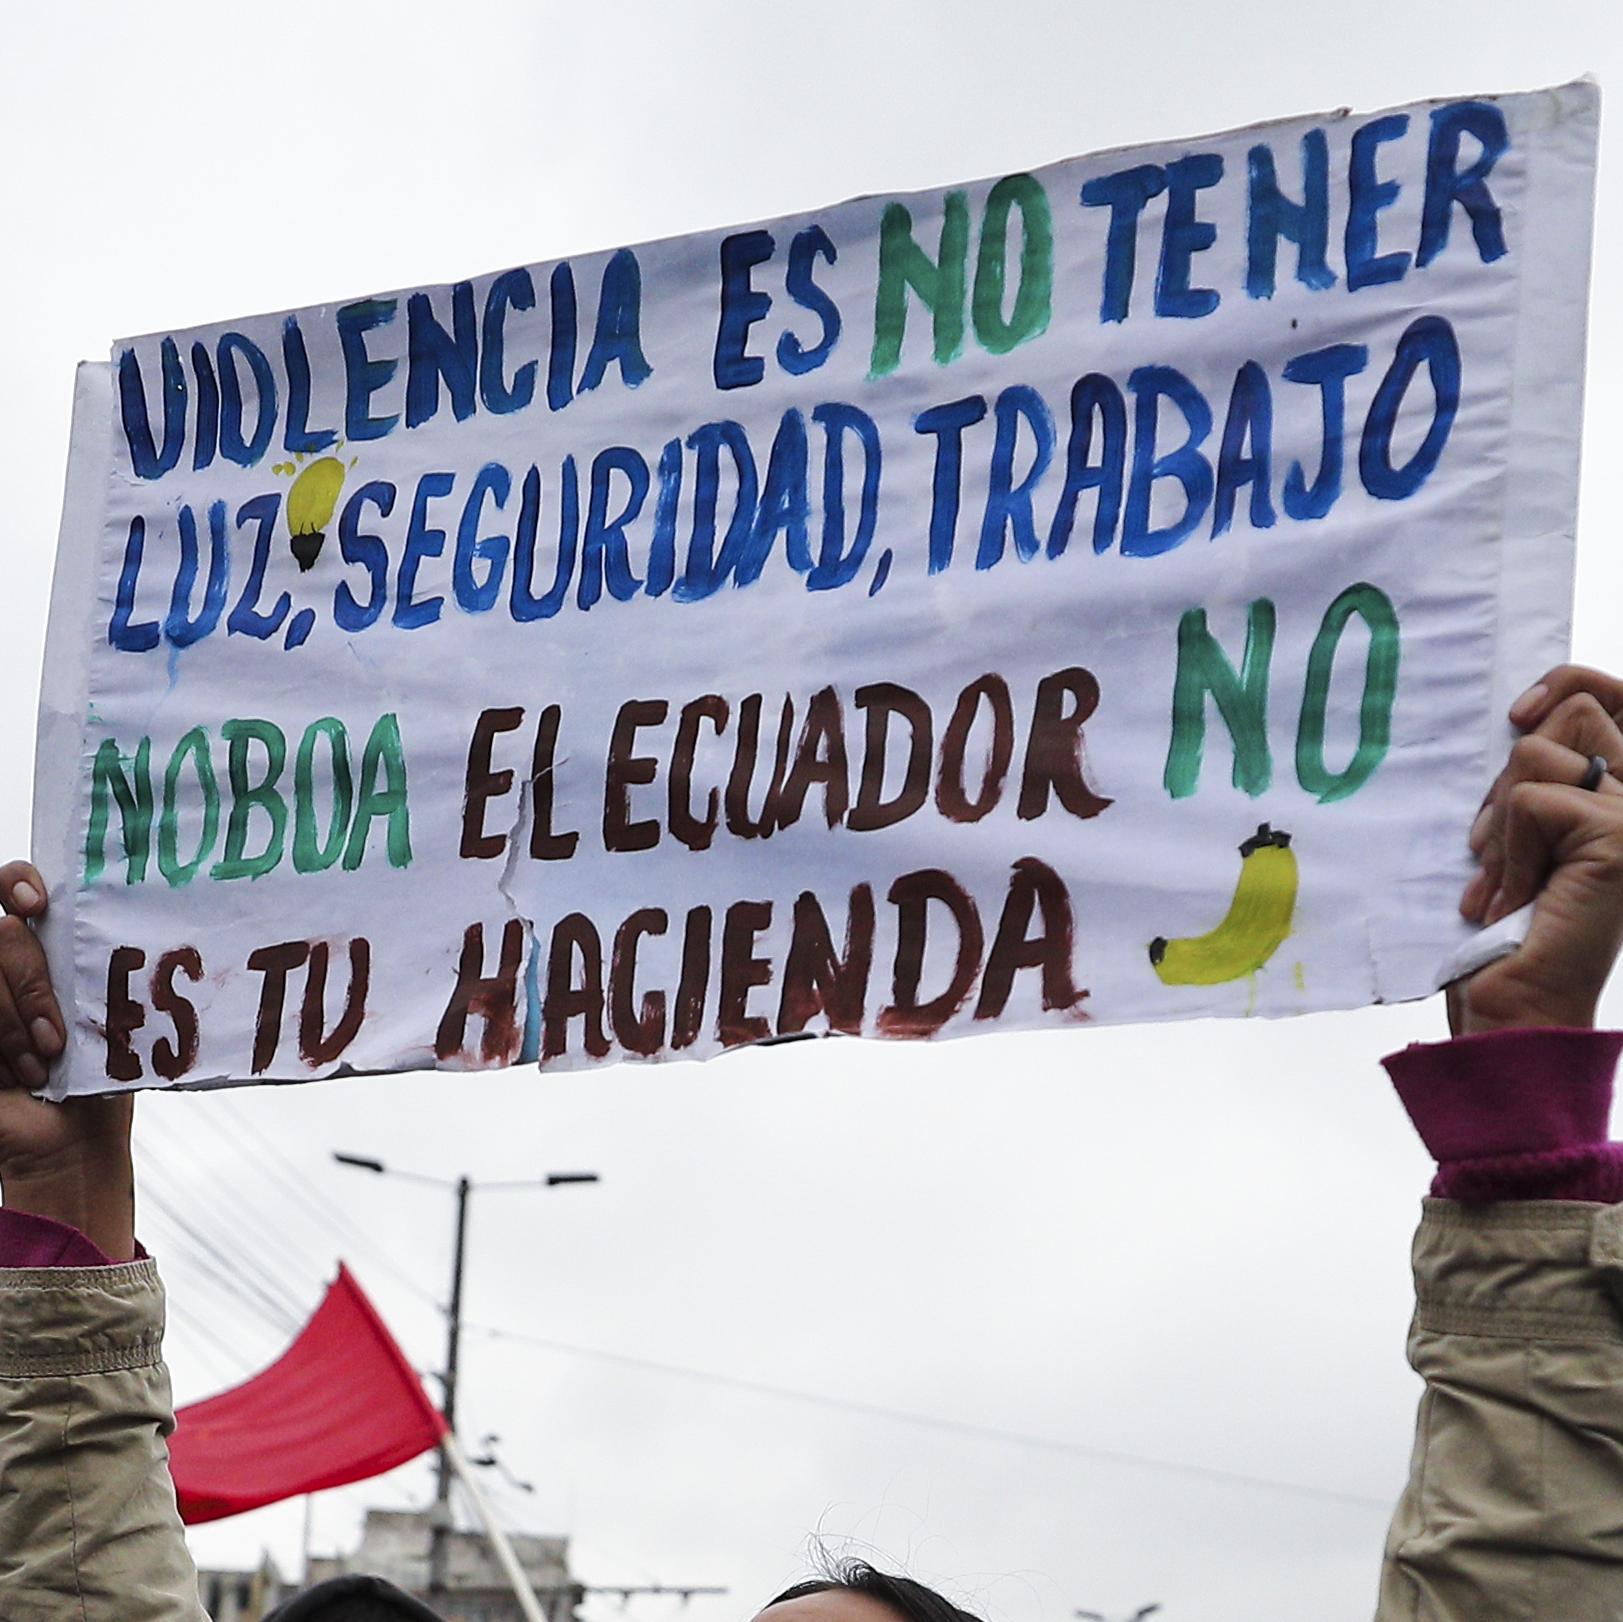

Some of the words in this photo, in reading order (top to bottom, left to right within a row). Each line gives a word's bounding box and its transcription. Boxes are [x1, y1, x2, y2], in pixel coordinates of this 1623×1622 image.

[118, 247, 653, 480] VIOLENCIA
[713, 224, 841, 390] ES
[864, 172, 1053, 382] NO
[1080, 101, 1509, 324] TENER
[107, 493, 315, 652] LUZ,
[333, 401, 892, 632] SEGURIDAD,
[914, 315, 1461, 576] TRABAJO
[84, 712, 413, 888] NOBOA
[459, 704, 579, 861] EL
[603, 665, 1115, 853] ECUADOR
[1164, 581, 1400, 804] NO
[105, 945, 203, 1080] ES
[246, 937, 370, 1076] TU
[435, 857, 1091, 1063] HACIENDA
